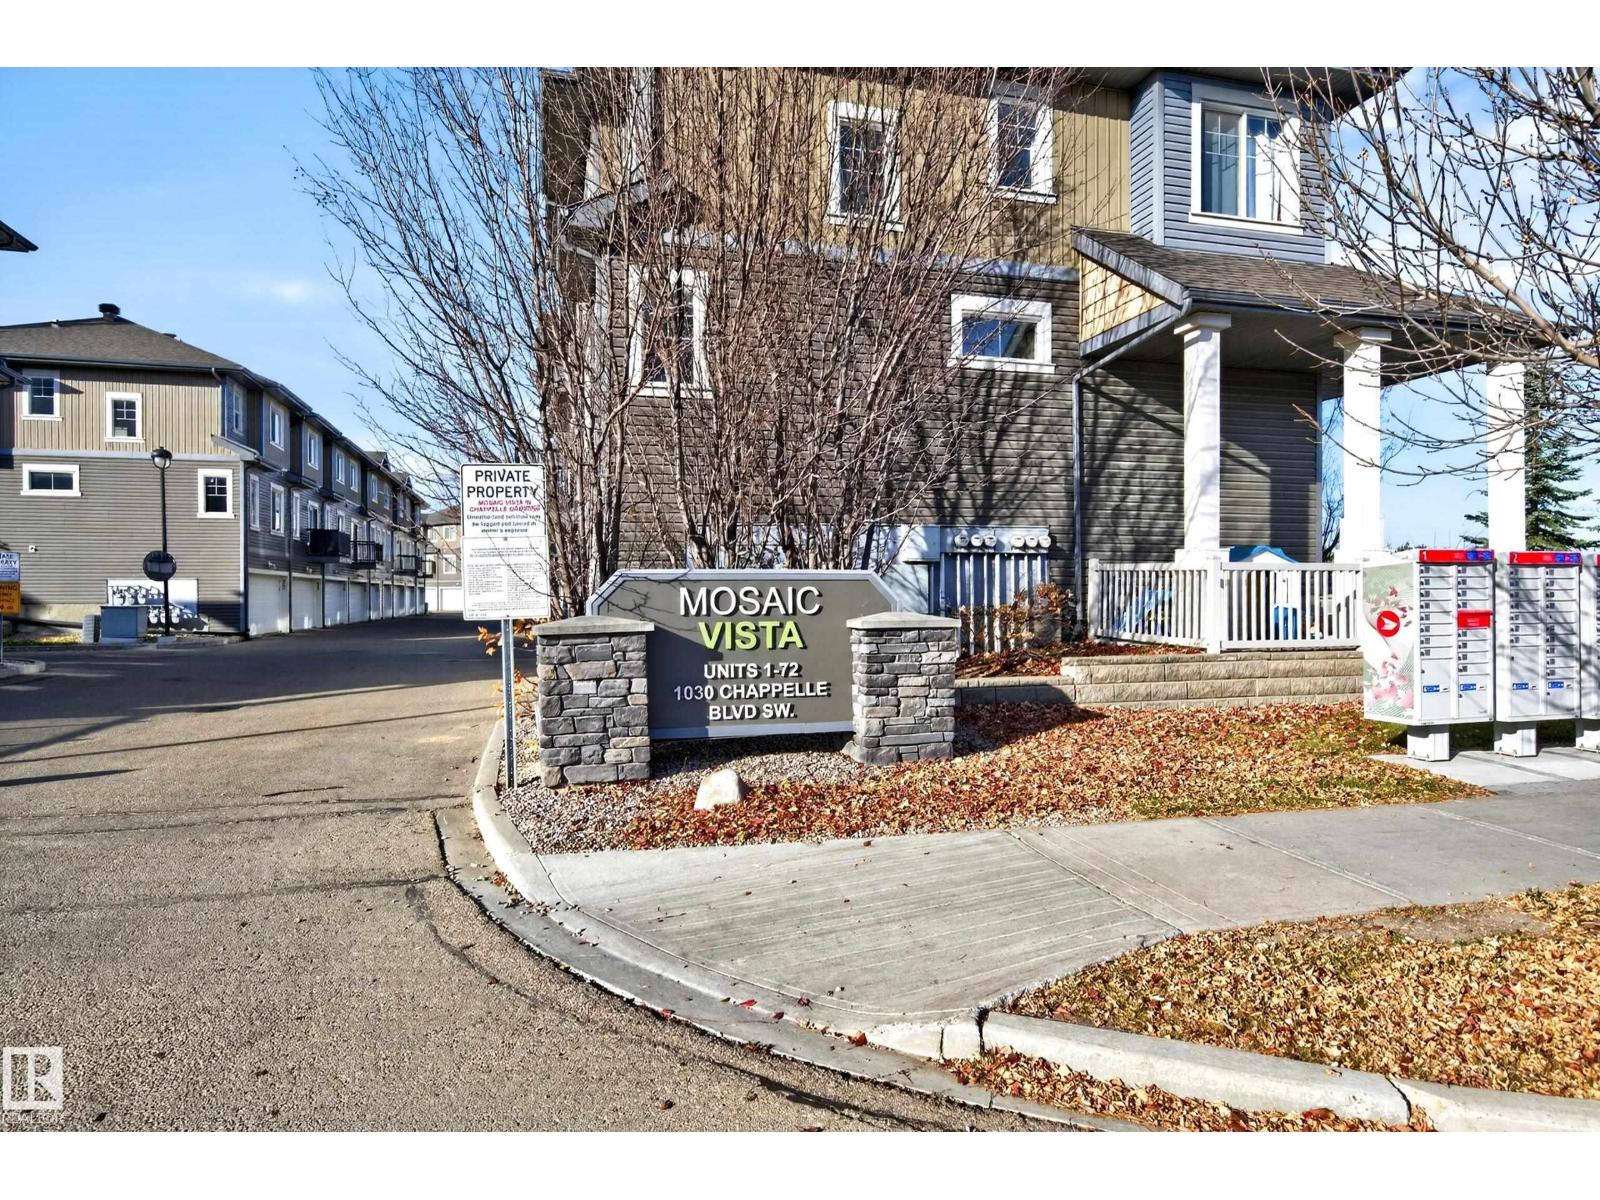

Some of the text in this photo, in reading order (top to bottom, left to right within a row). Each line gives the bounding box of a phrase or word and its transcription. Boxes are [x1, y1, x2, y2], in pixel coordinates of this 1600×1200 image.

[475, 469, 530, 482] PRIVATE
[467, 486, 539, 498] PROPERTY
[1422, 550, 1427, 561] 1
[1513, 553, 1519, 563] 2
[679, 586, 821, 616] MOSAIC
[698, 620, 805, 650] VISTA
[703, 662, 799, 680] UNITS 1-72
[673, 681, 829, 701] 1030 CHAPPELLE
[708, 703, 797, 721] BLVD SW.
